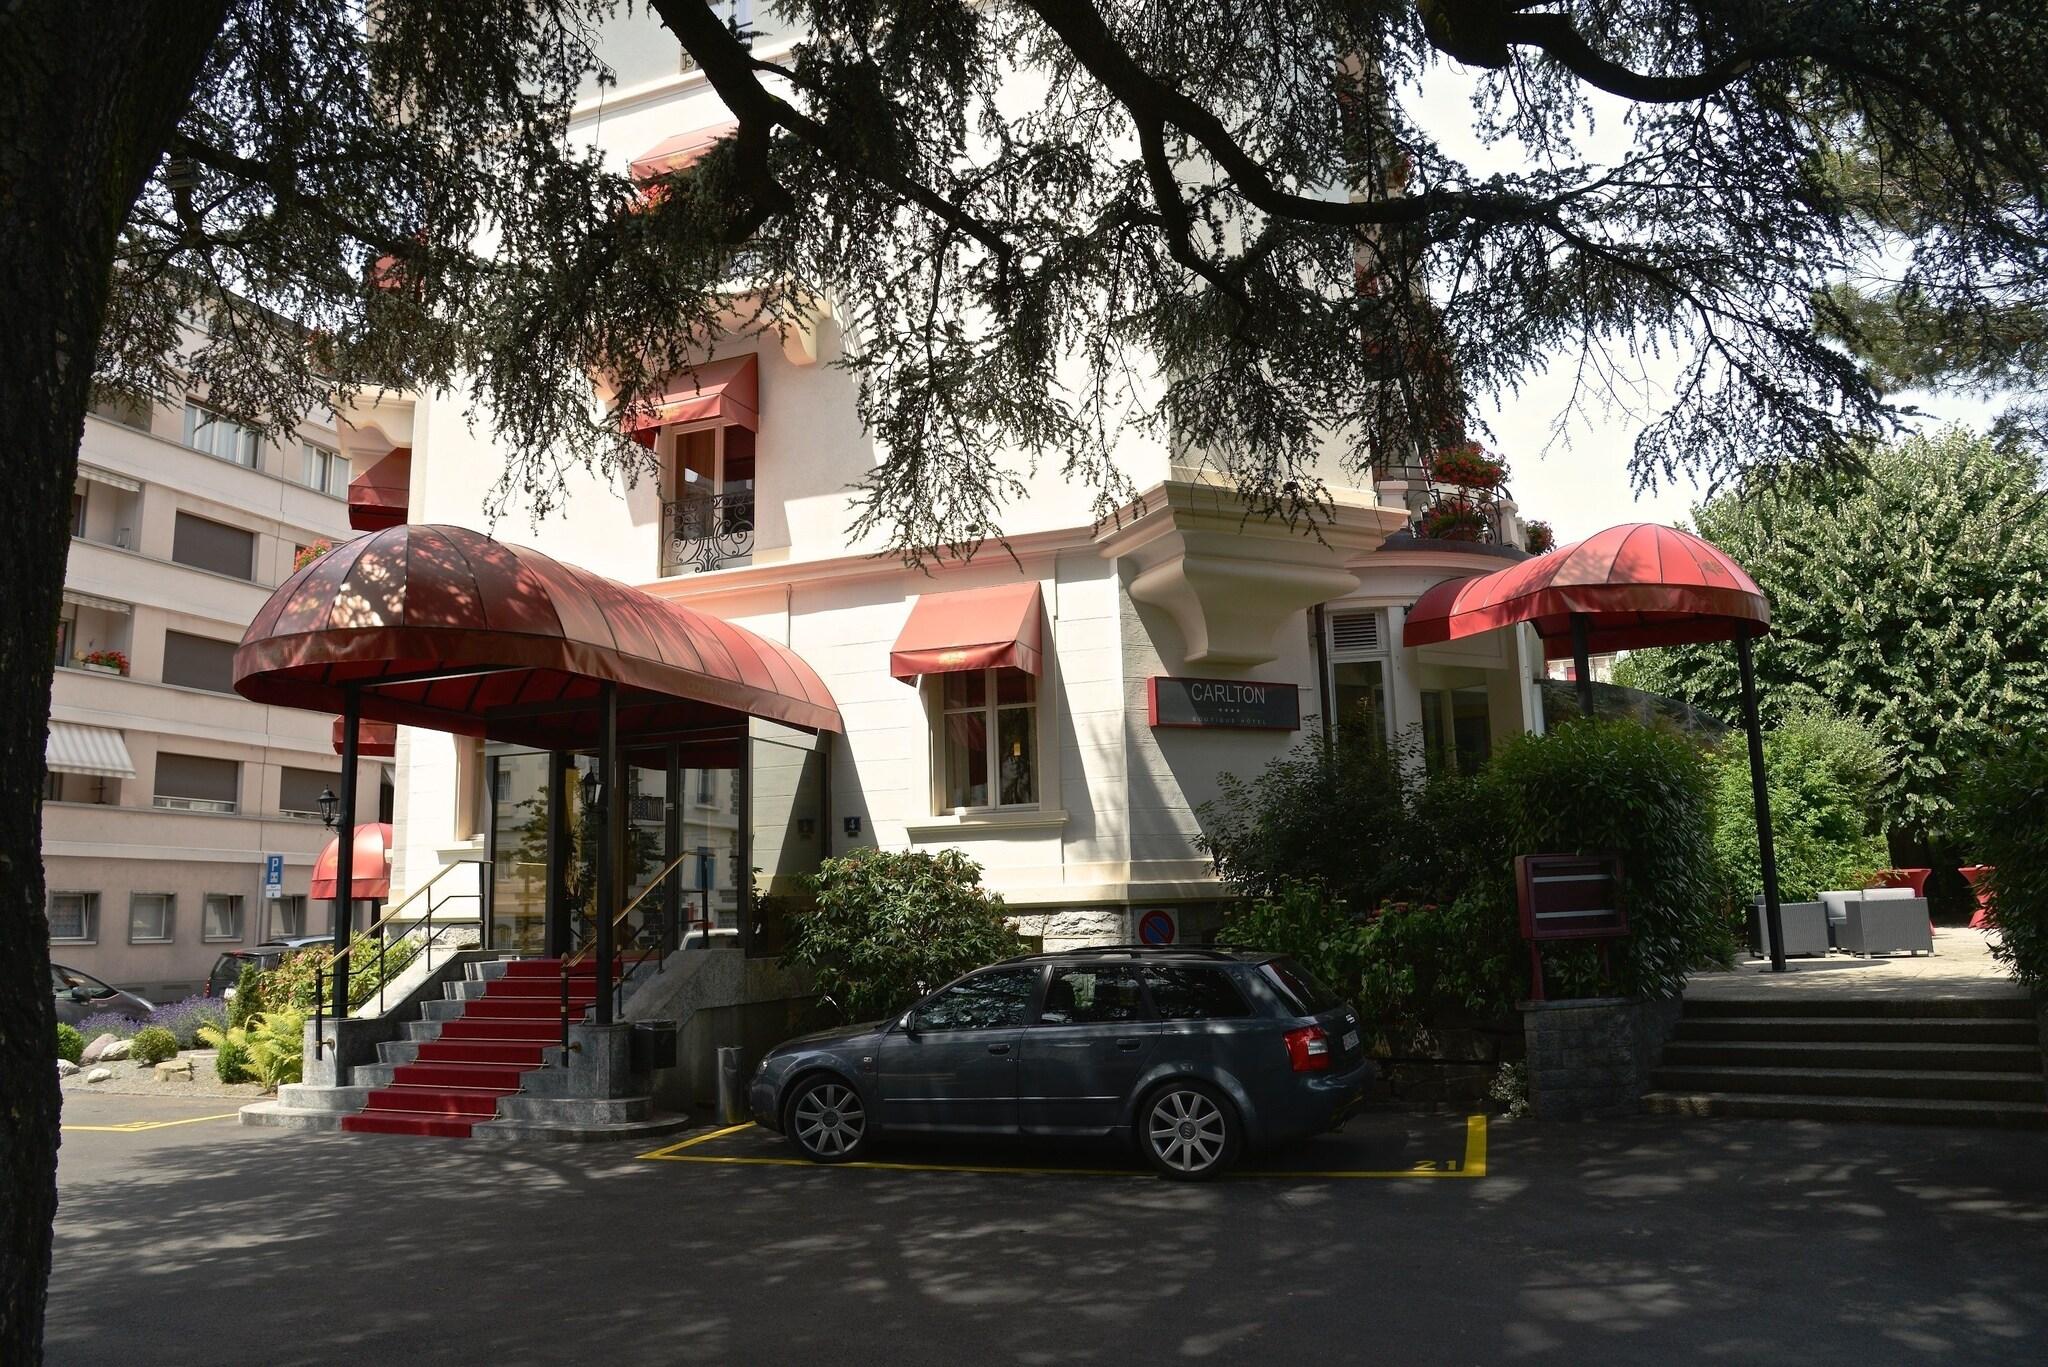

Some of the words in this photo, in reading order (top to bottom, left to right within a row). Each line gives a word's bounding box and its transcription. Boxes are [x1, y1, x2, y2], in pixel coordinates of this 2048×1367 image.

[1191, 683, 1265, 704] CARLTON
[271, 857, 279, 872] P
[1412, 1160, 1457, 1171] 21
